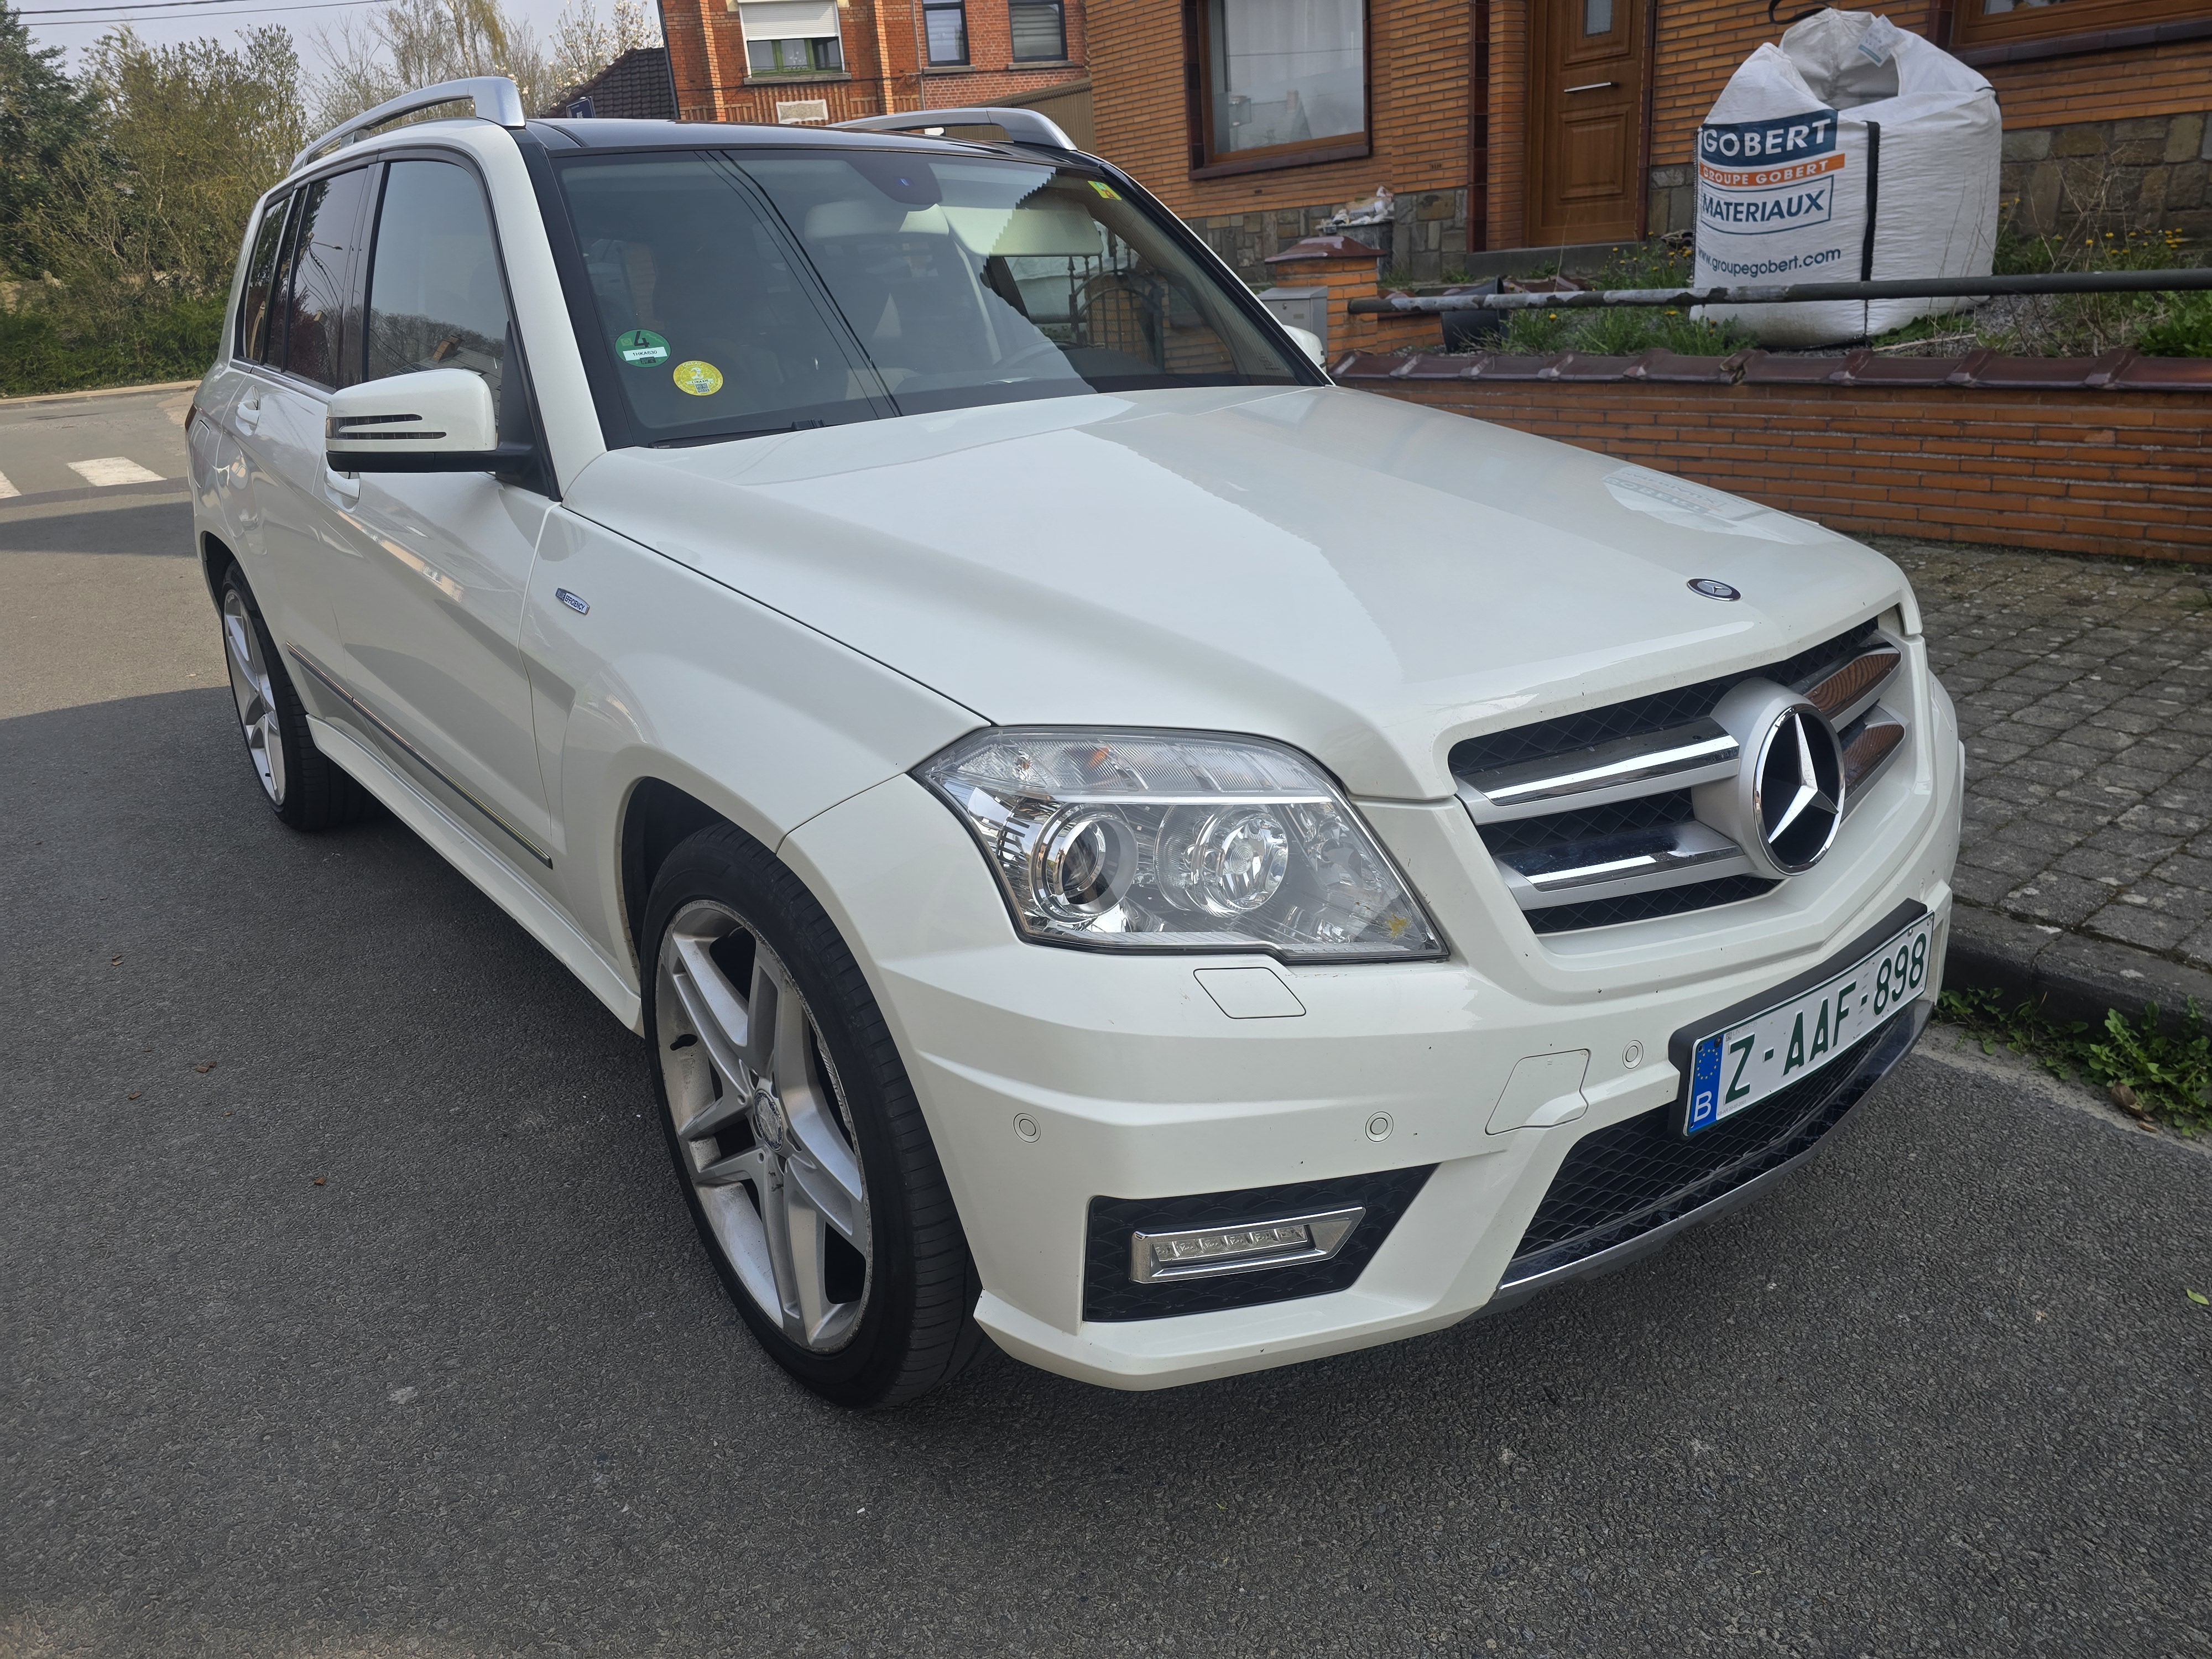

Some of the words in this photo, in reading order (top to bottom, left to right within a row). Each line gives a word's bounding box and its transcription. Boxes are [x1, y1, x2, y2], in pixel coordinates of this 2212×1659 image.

[1703, 118, 1831, 156] GOBERT
[1703, 167, 1749, 185] GROUPE
[1756, 160, 1828, 184] GOBERT
[1702, 189, 1825, 222] MATERIAUX
[1698, 248, 1841, 278] www.groupegobert.com
[634, 331, 650, 348] 4
[691, 367, 704, 380] 2
[565, 595, 585, 611] EFFICIENCY
[1724, 933, 1927, 1105] Z-AAF-898
[1693, 1091, 1713, 1123] B
